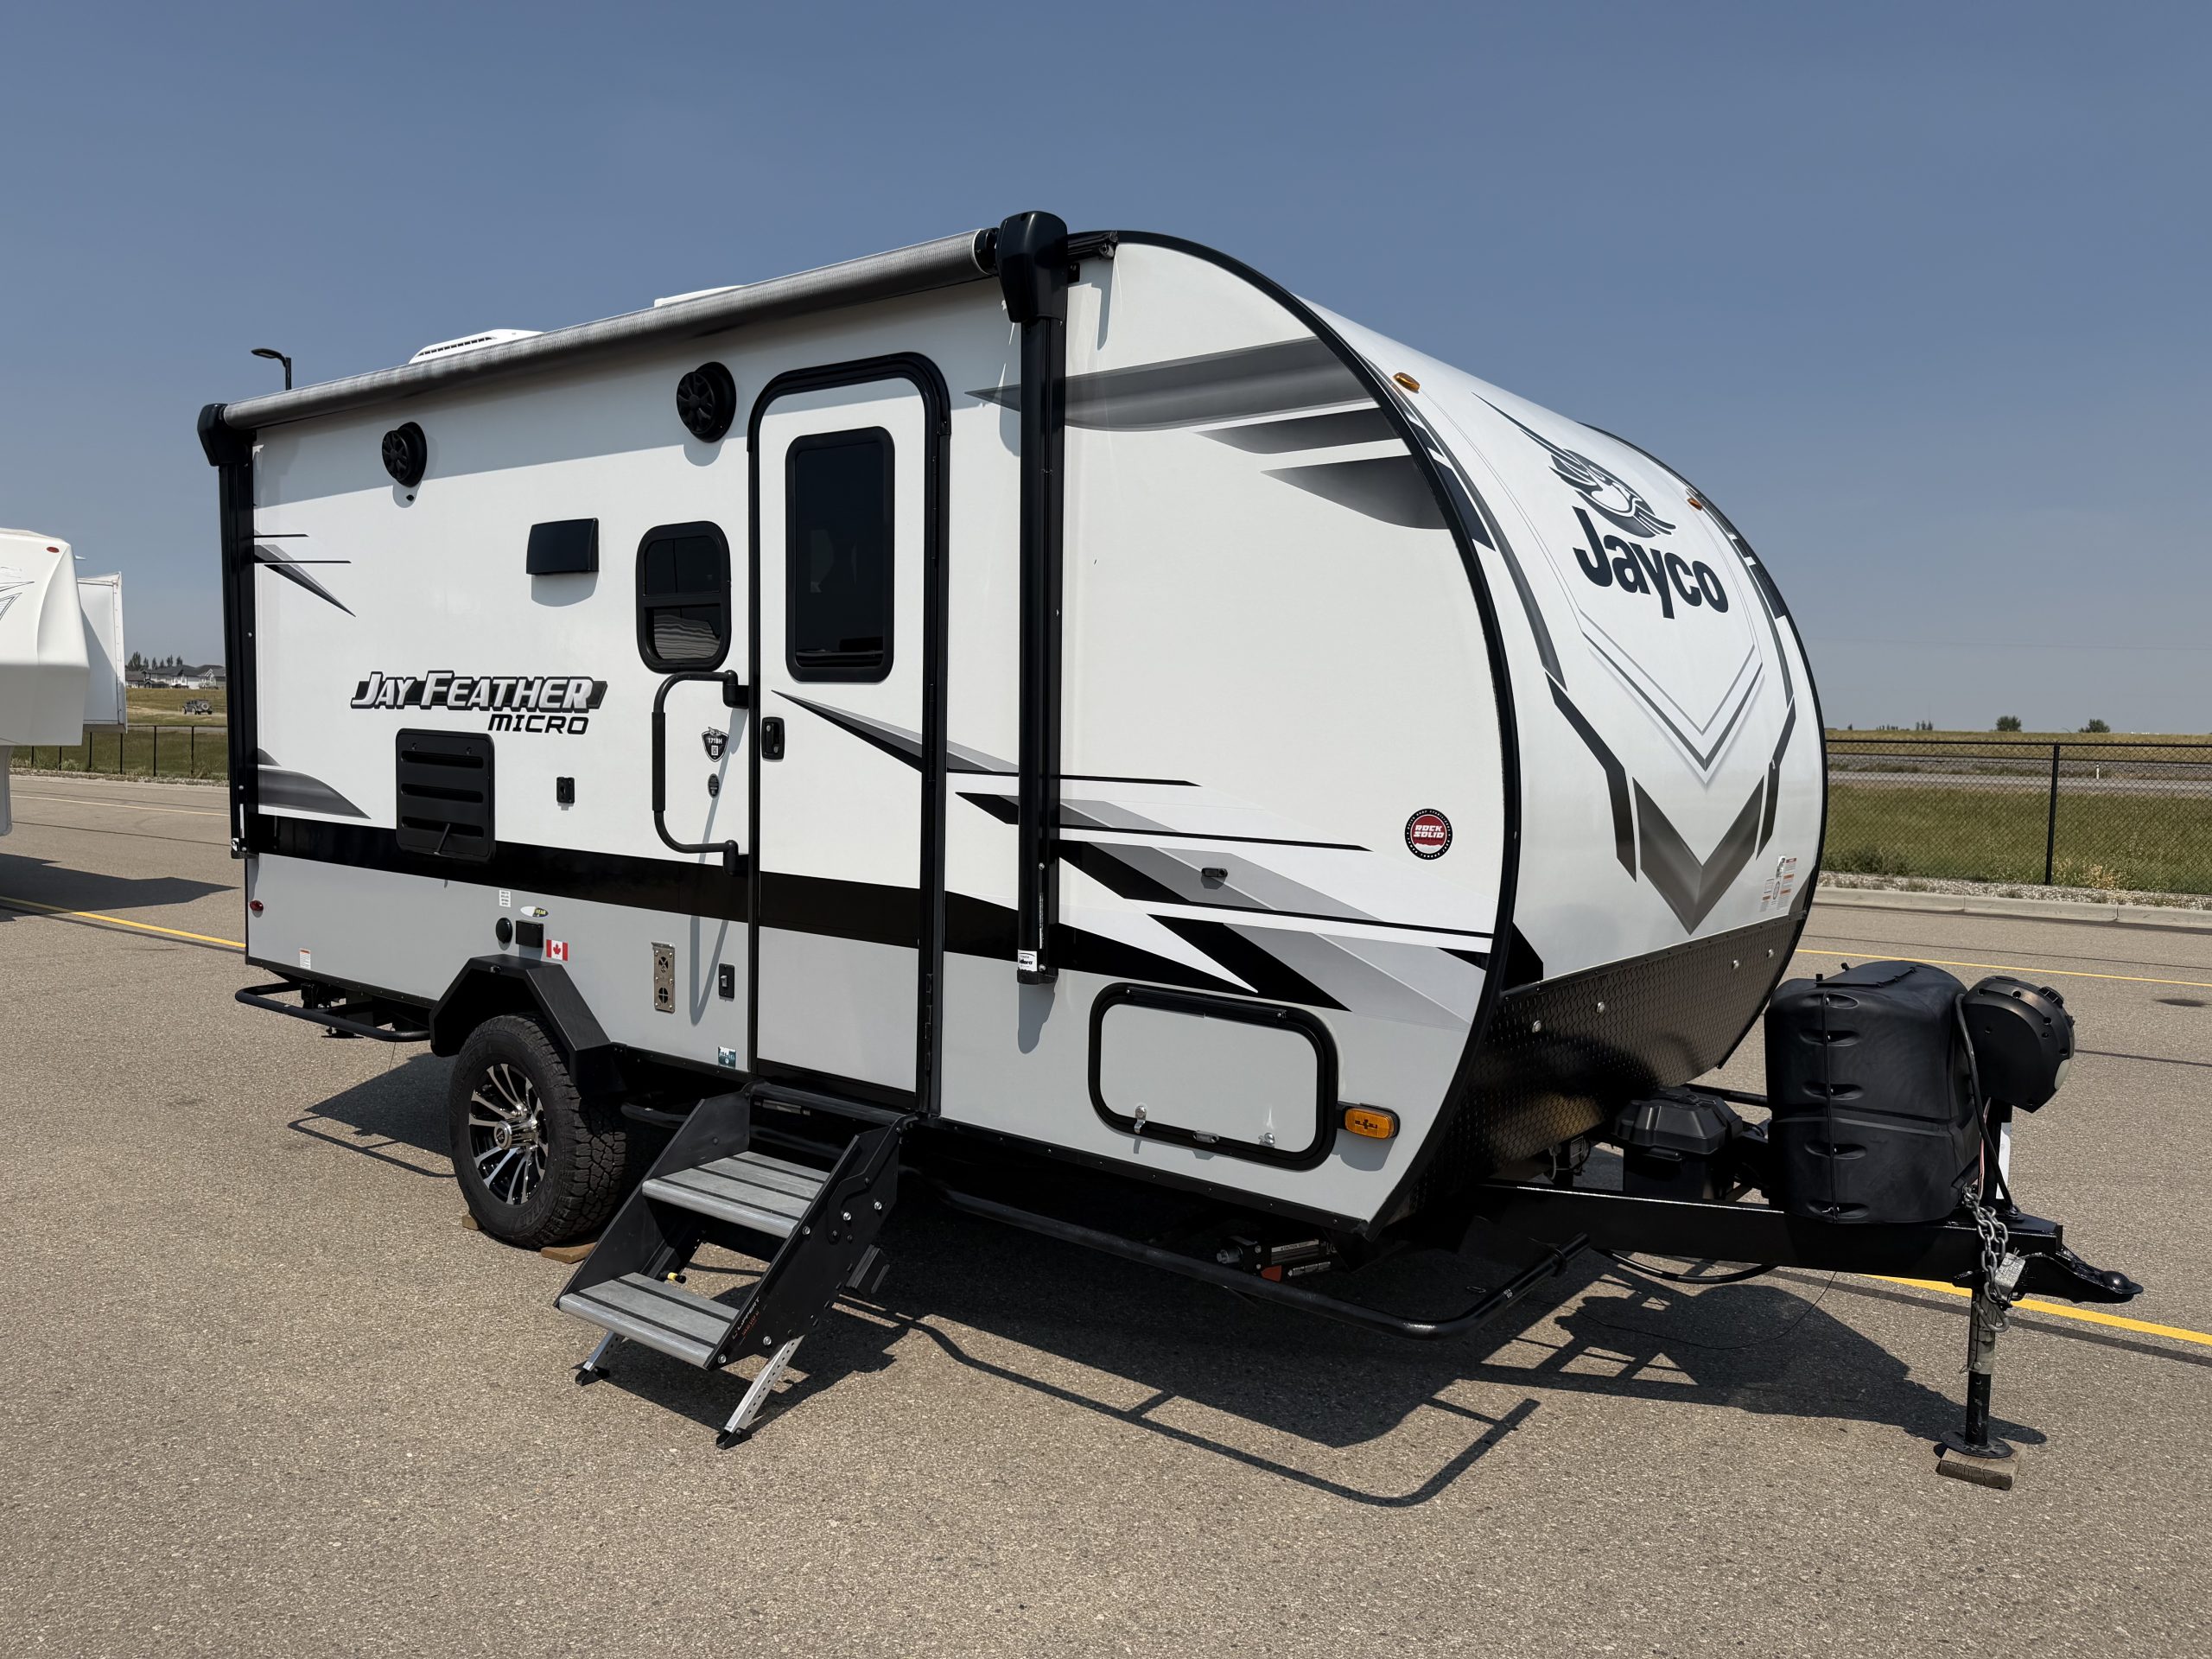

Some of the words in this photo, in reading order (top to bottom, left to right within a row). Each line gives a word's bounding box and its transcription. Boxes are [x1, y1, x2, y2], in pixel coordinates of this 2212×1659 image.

[1572, 505, 1729, 620] Jayco
[351, 671, 416, 709] JAY
[420, 670, 594, 713] FEATHER
[487, 714, 589, 734] MICRO
